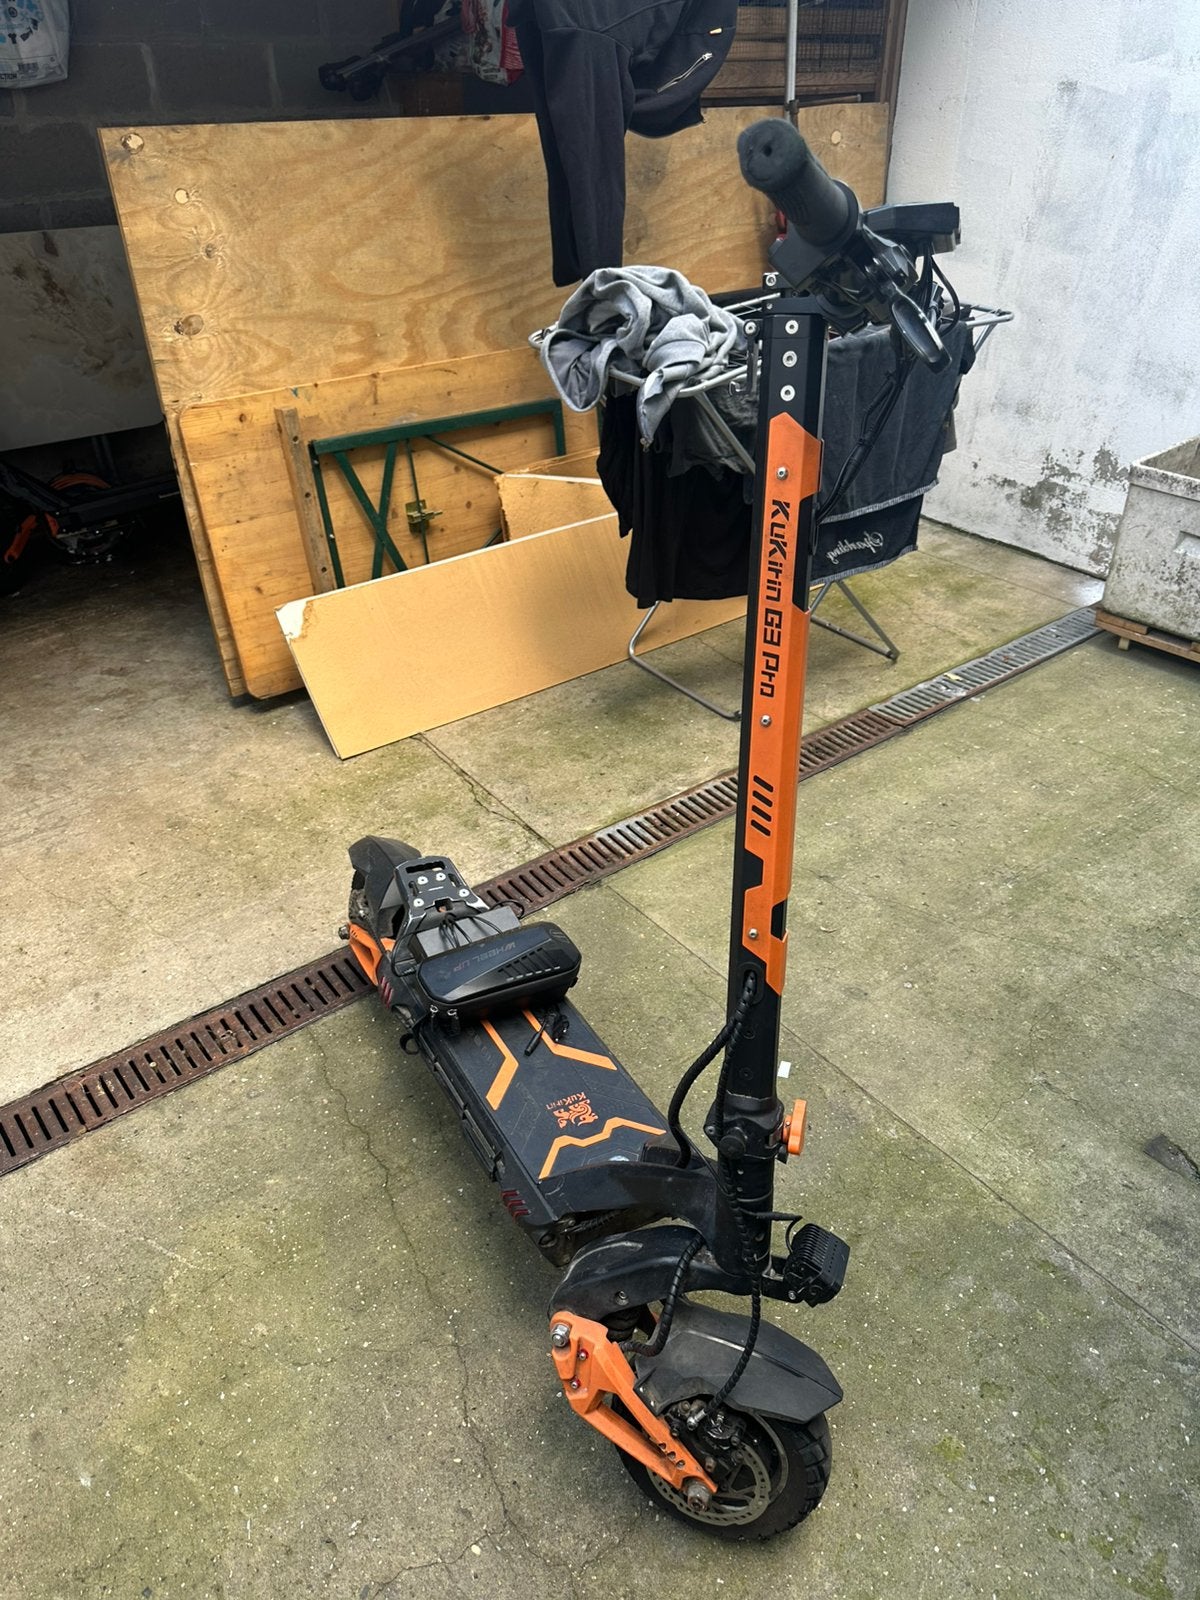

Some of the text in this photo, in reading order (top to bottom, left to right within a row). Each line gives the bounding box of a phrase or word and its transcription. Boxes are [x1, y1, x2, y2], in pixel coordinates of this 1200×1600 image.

[760, 499, 790, 697] KuKirin G3 Pro
[453, 941, 517, 971] WHEEL UP
[546, 1091, 587, 1110] KuKirin
